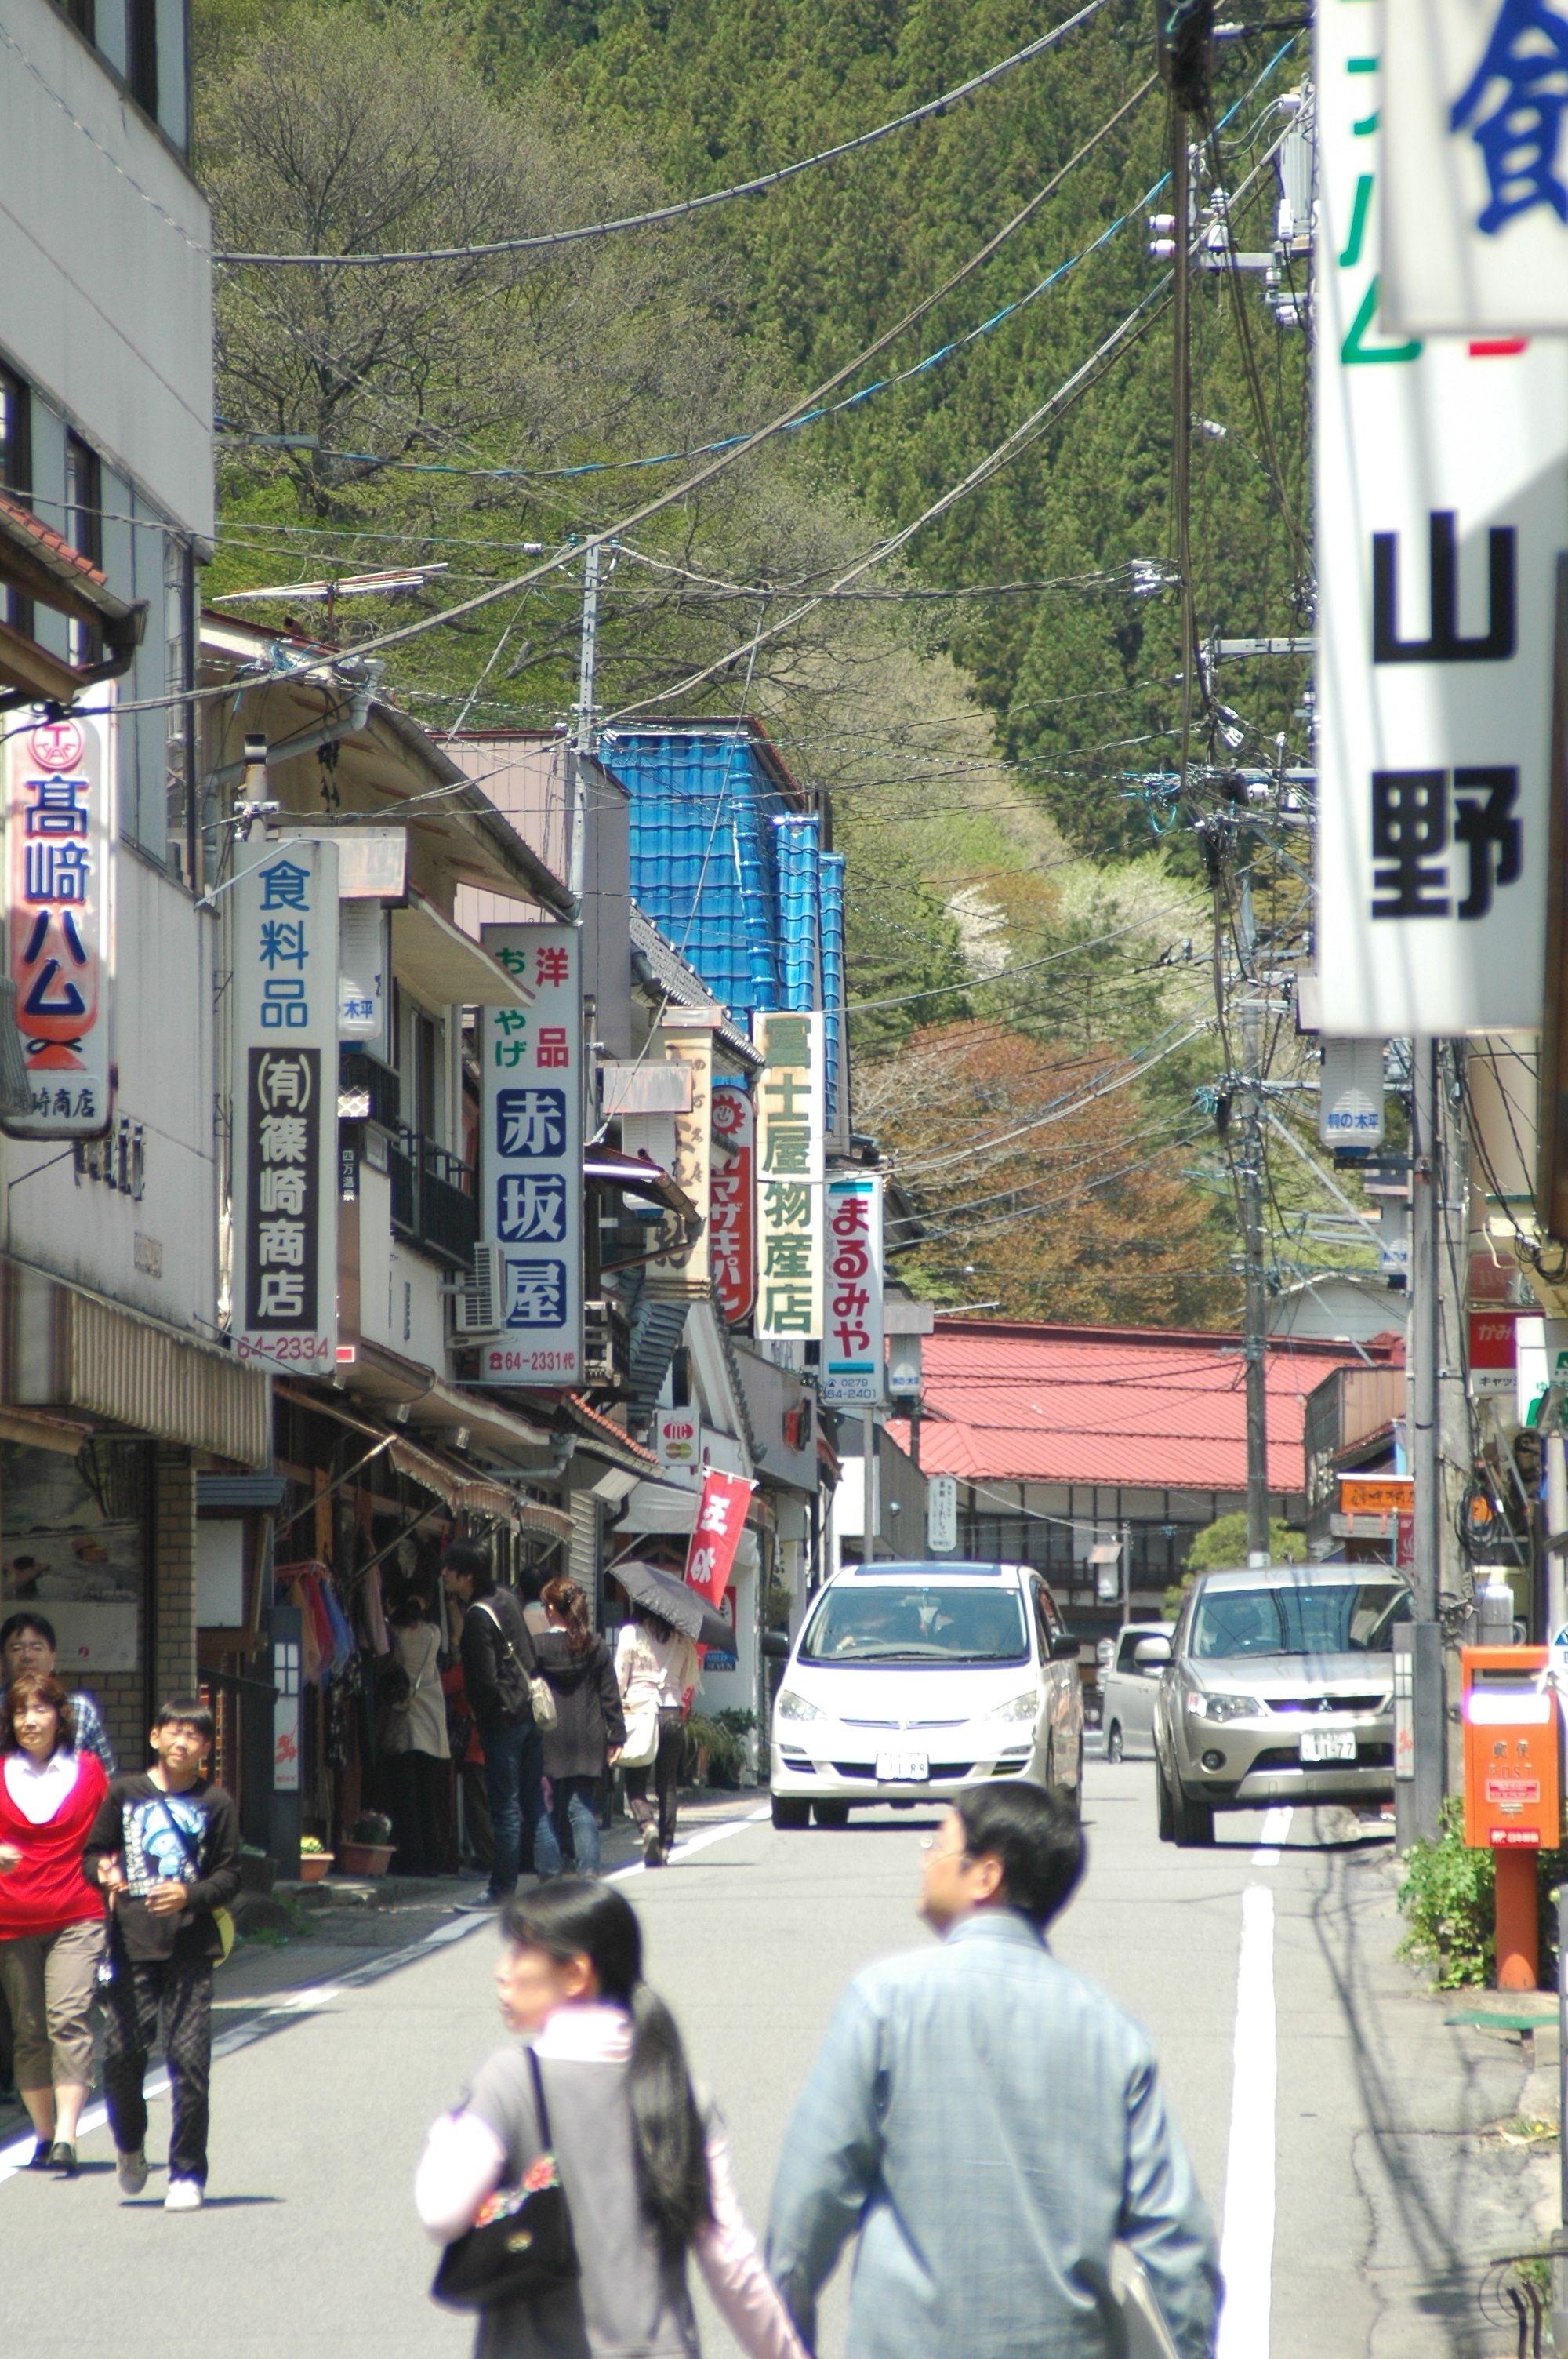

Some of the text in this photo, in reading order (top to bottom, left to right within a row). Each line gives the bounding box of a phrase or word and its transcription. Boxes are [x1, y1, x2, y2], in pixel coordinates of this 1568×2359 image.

[1372, 510, 1524, 920] 山野
[258, 860, 311, 1029] 食料品
[494, 947, 527, 1068] おやげ
[535, 947, 569, 1068] 洋品
[502, 1092, 564, 1323] 赤坂屋
[833, 1198, 870, 1358] まるみや
[238, 1336, 329, 1360] 64-2334
[827, 1388, 877, 1398] 64-2401
[841, 1379, 868, 1387] 0279
